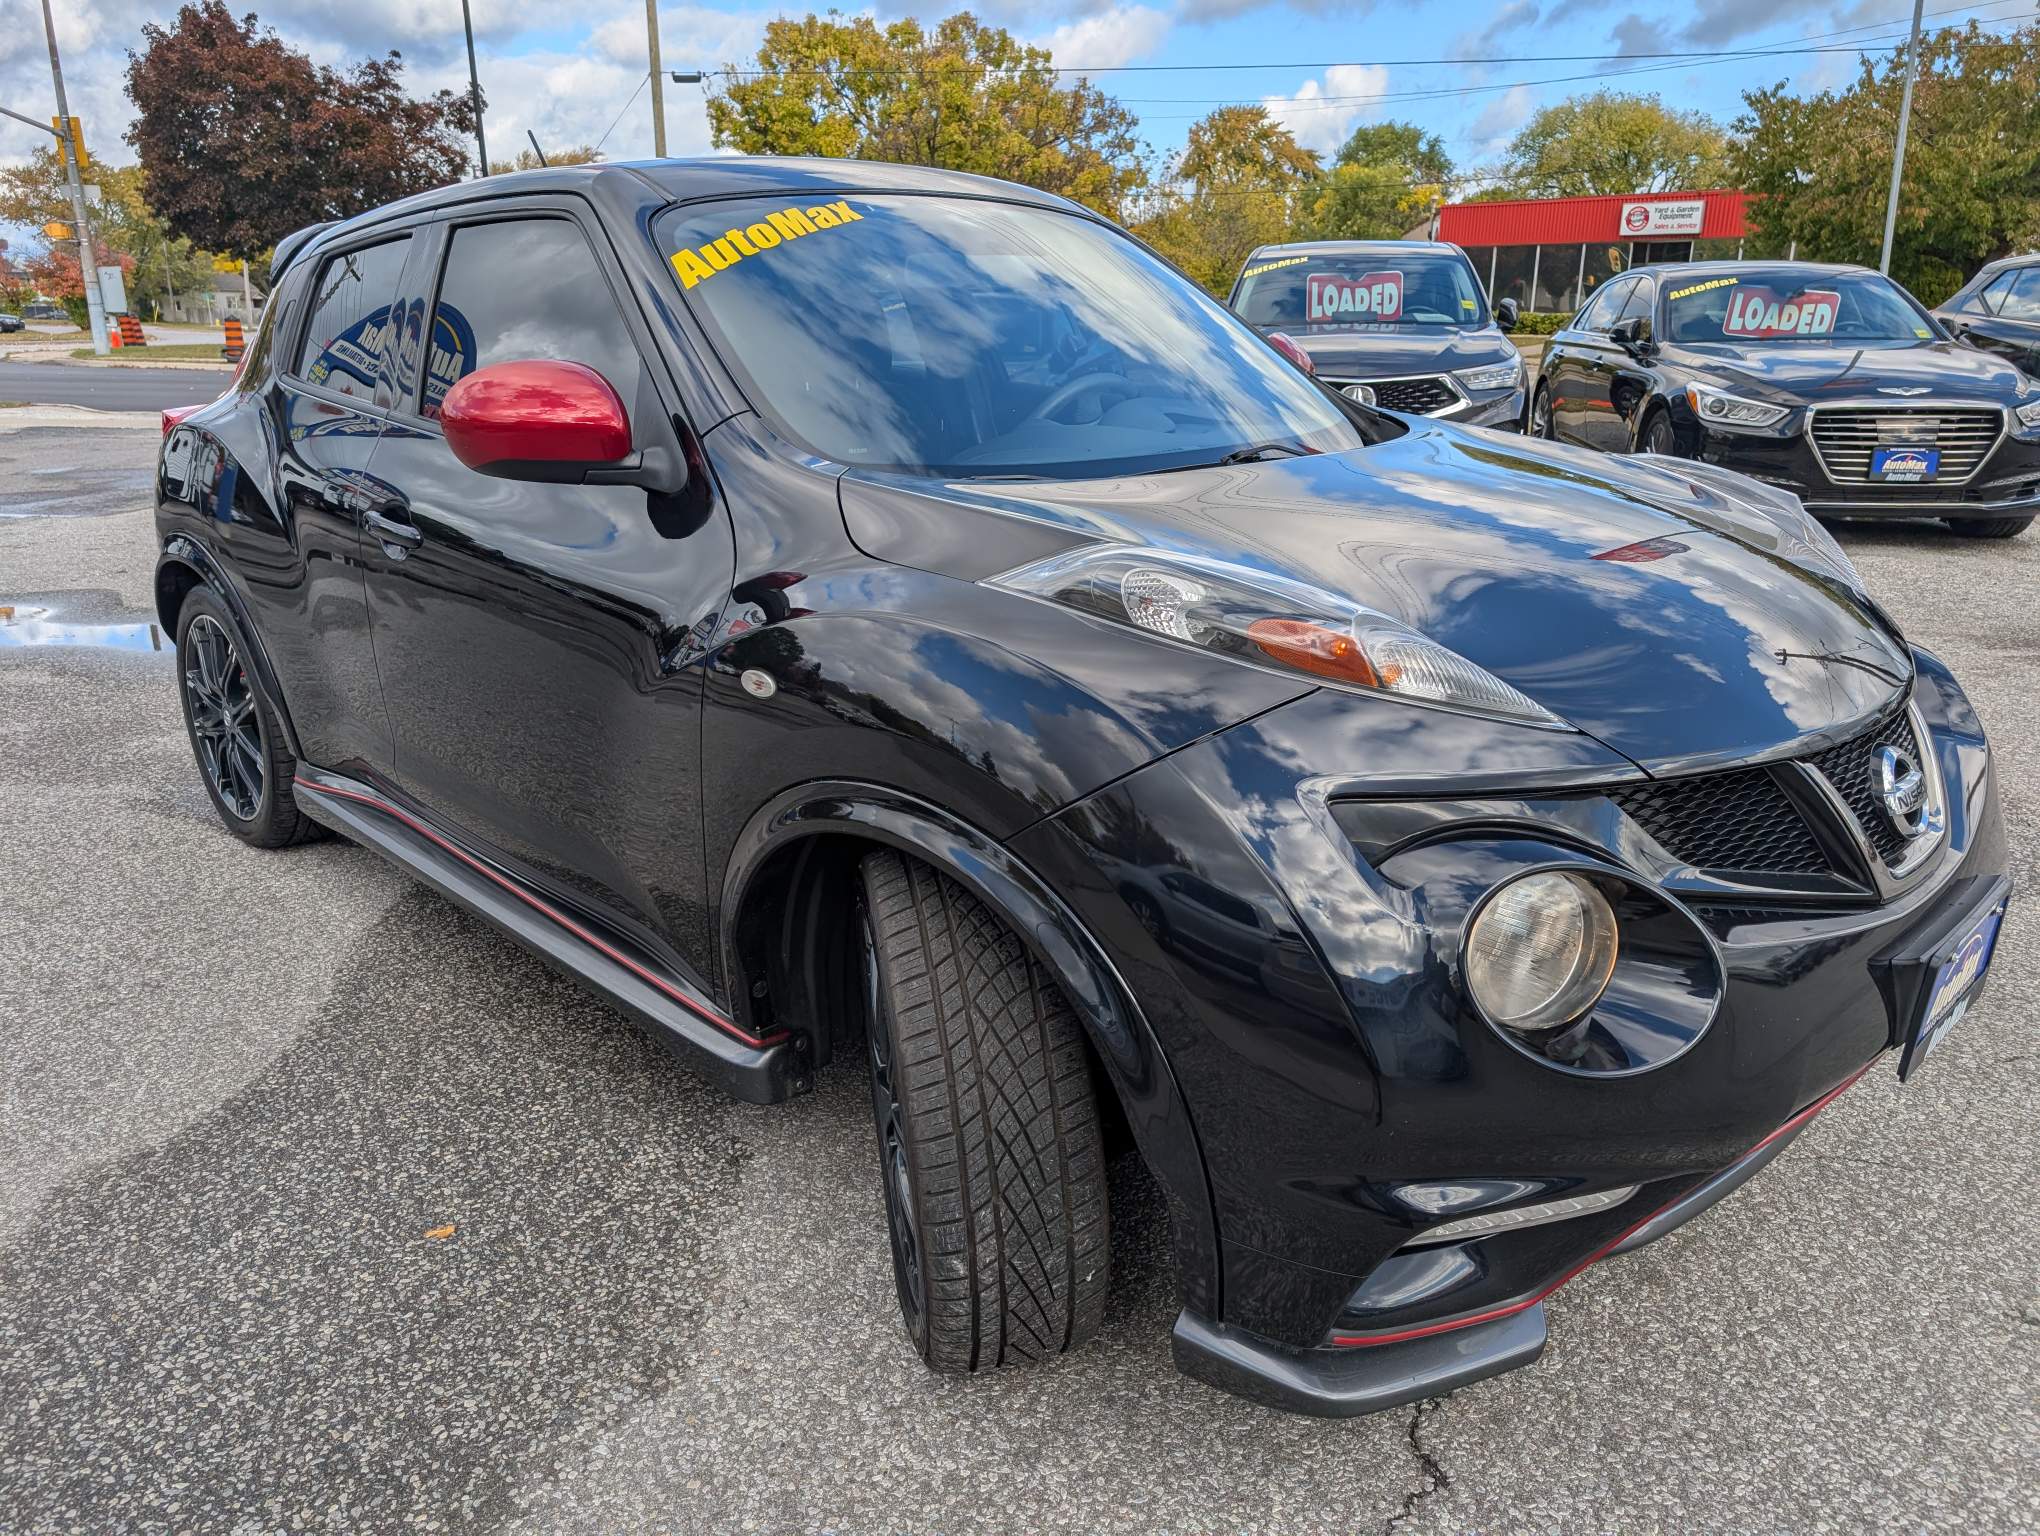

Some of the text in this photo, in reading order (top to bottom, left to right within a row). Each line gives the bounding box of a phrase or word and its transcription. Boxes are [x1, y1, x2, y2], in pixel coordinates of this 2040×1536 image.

[1658, 212, 1693, 220] Equipment
[1676, 222, 1697, 230] Service
[670, 201, 864, 290] AutoMax
[1243, 256, 1309, 278] AutoMax
[1311, 281, 1399, 318] LOADED
[1669, 277, 1738, 300] AutoMax
[1729, 292, 1832, 334] LOADED
[1882, 460, 1928, 470] AutoMax
[1885, 473, 1922, 481] AutoMax
[1897, 774, 1926, 810] NISS
